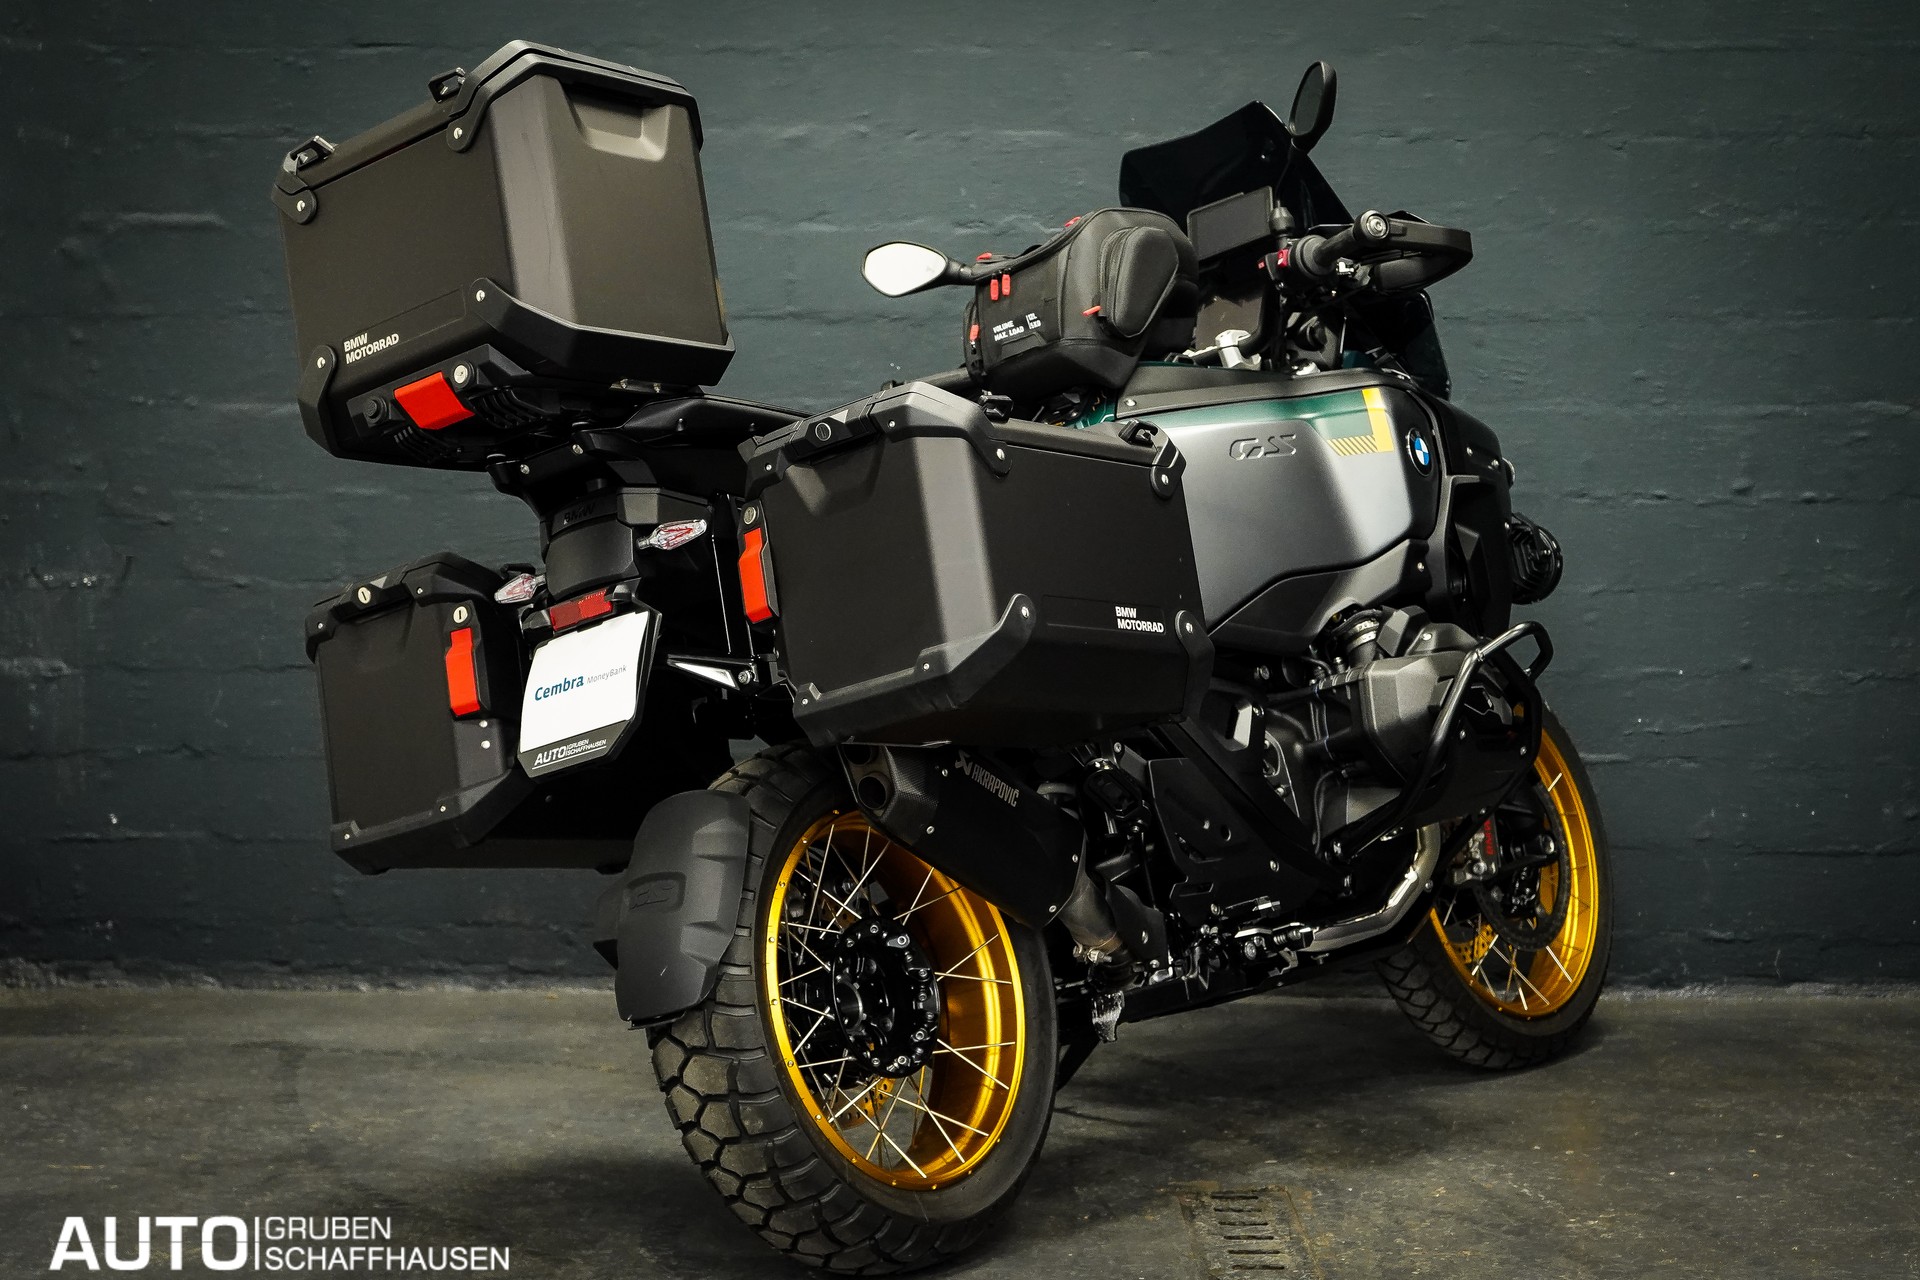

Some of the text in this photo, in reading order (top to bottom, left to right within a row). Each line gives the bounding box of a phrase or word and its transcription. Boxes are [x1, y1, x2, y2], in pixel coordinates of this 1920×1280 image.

[1009, 325, 1025, 336] LOAD
[343, 332, 368, 352] BMW
[345, 333, 400, 364] MOTORRAD
[1229, 433, 1297, 461] GS
[1114, 606, 1137, 619] BMW
[1117, 618, 1165, 633] MOTORRAD
[534, 664, 628, 701] Cembra MoneyBank
[566, 739, 607, 756] SCHAFFHAUSEN
[567, 738, 590, 750] GRUBEN
[534, 745, 567, 767] AUTO
